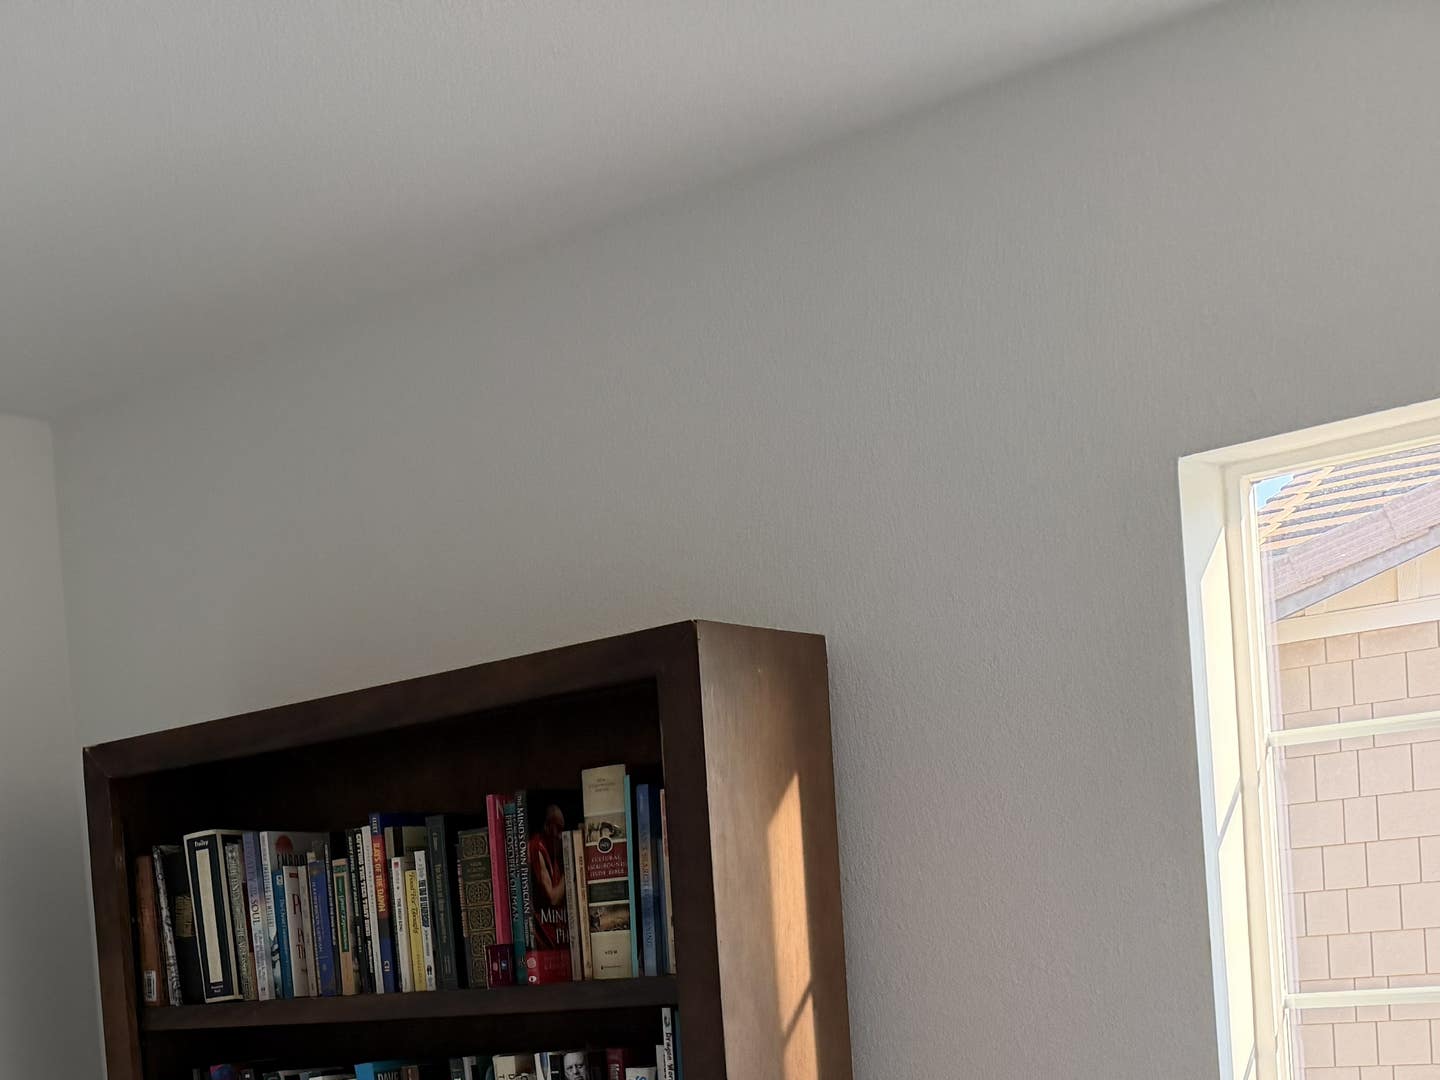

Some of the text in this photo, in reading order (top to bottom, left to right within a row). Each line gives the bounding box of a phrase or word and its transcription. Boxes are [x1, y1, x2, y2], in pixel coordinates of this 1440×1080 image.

[355, 833, 363, 865] CUTTING
[519, 841, 528, 865] OWN
[377, 889, 386, 912] DAWN
[521, 867, 531, 914] PHYSICIAN
[250, 899, 259, 925] SOUL
[665, 1032, 674, 1061] Dragon
